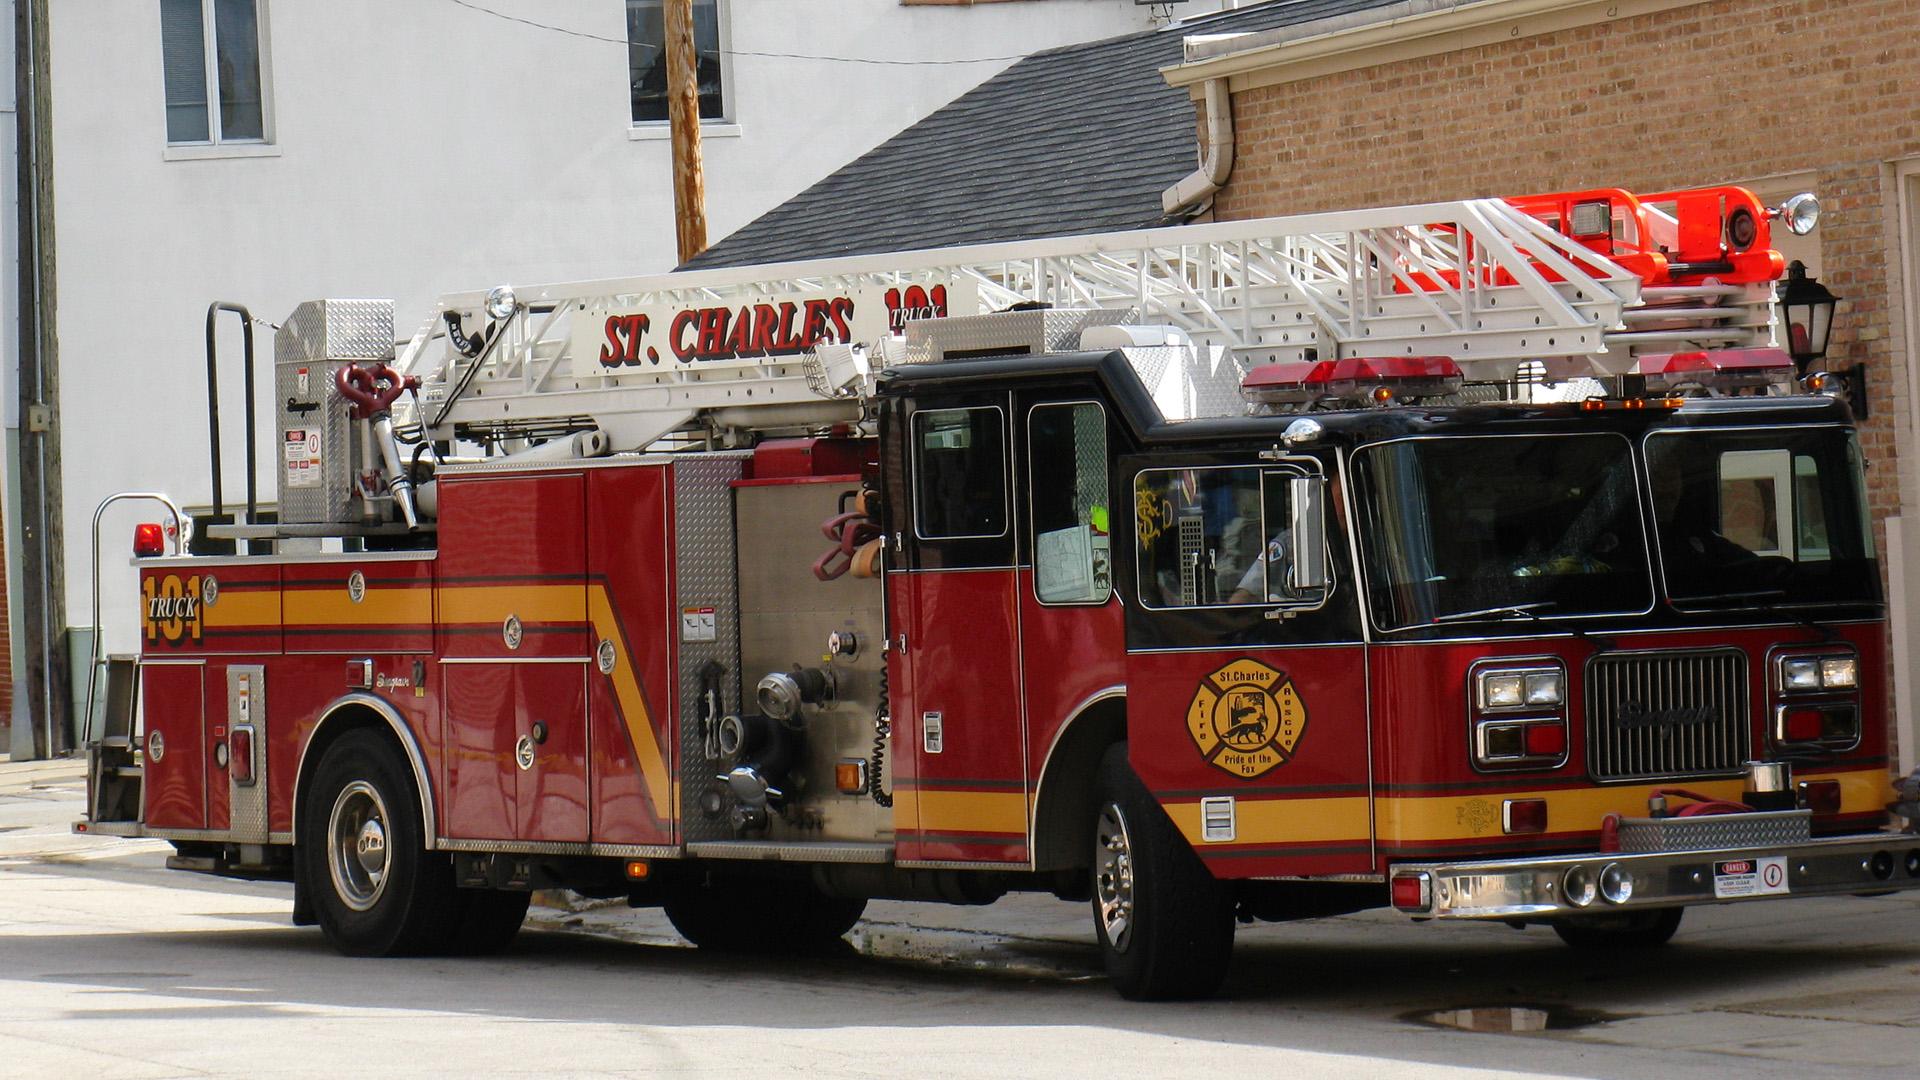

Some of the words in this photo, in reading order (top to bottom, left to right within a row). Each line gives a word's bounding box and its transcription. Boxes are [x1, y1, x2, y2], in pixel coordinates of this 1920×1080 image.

[892, 306, 940, 326] TRUCK
[600, 314, 659, 368] ST.
[669, 297, 854, 363] CHARLES
[143, 575, 203, 646] 101
[149, 597, 197, 619] TRUCK
[1198, 699, 1207, 740] Fire
[1283, 688, 1292, 746] Rescue
[1224, 755, 1245, 764] Pride
[1247, 755, 1256, 764] of
[1258, 754, 1272, 763] the
[1241, 764, 1255, 774] Fox
